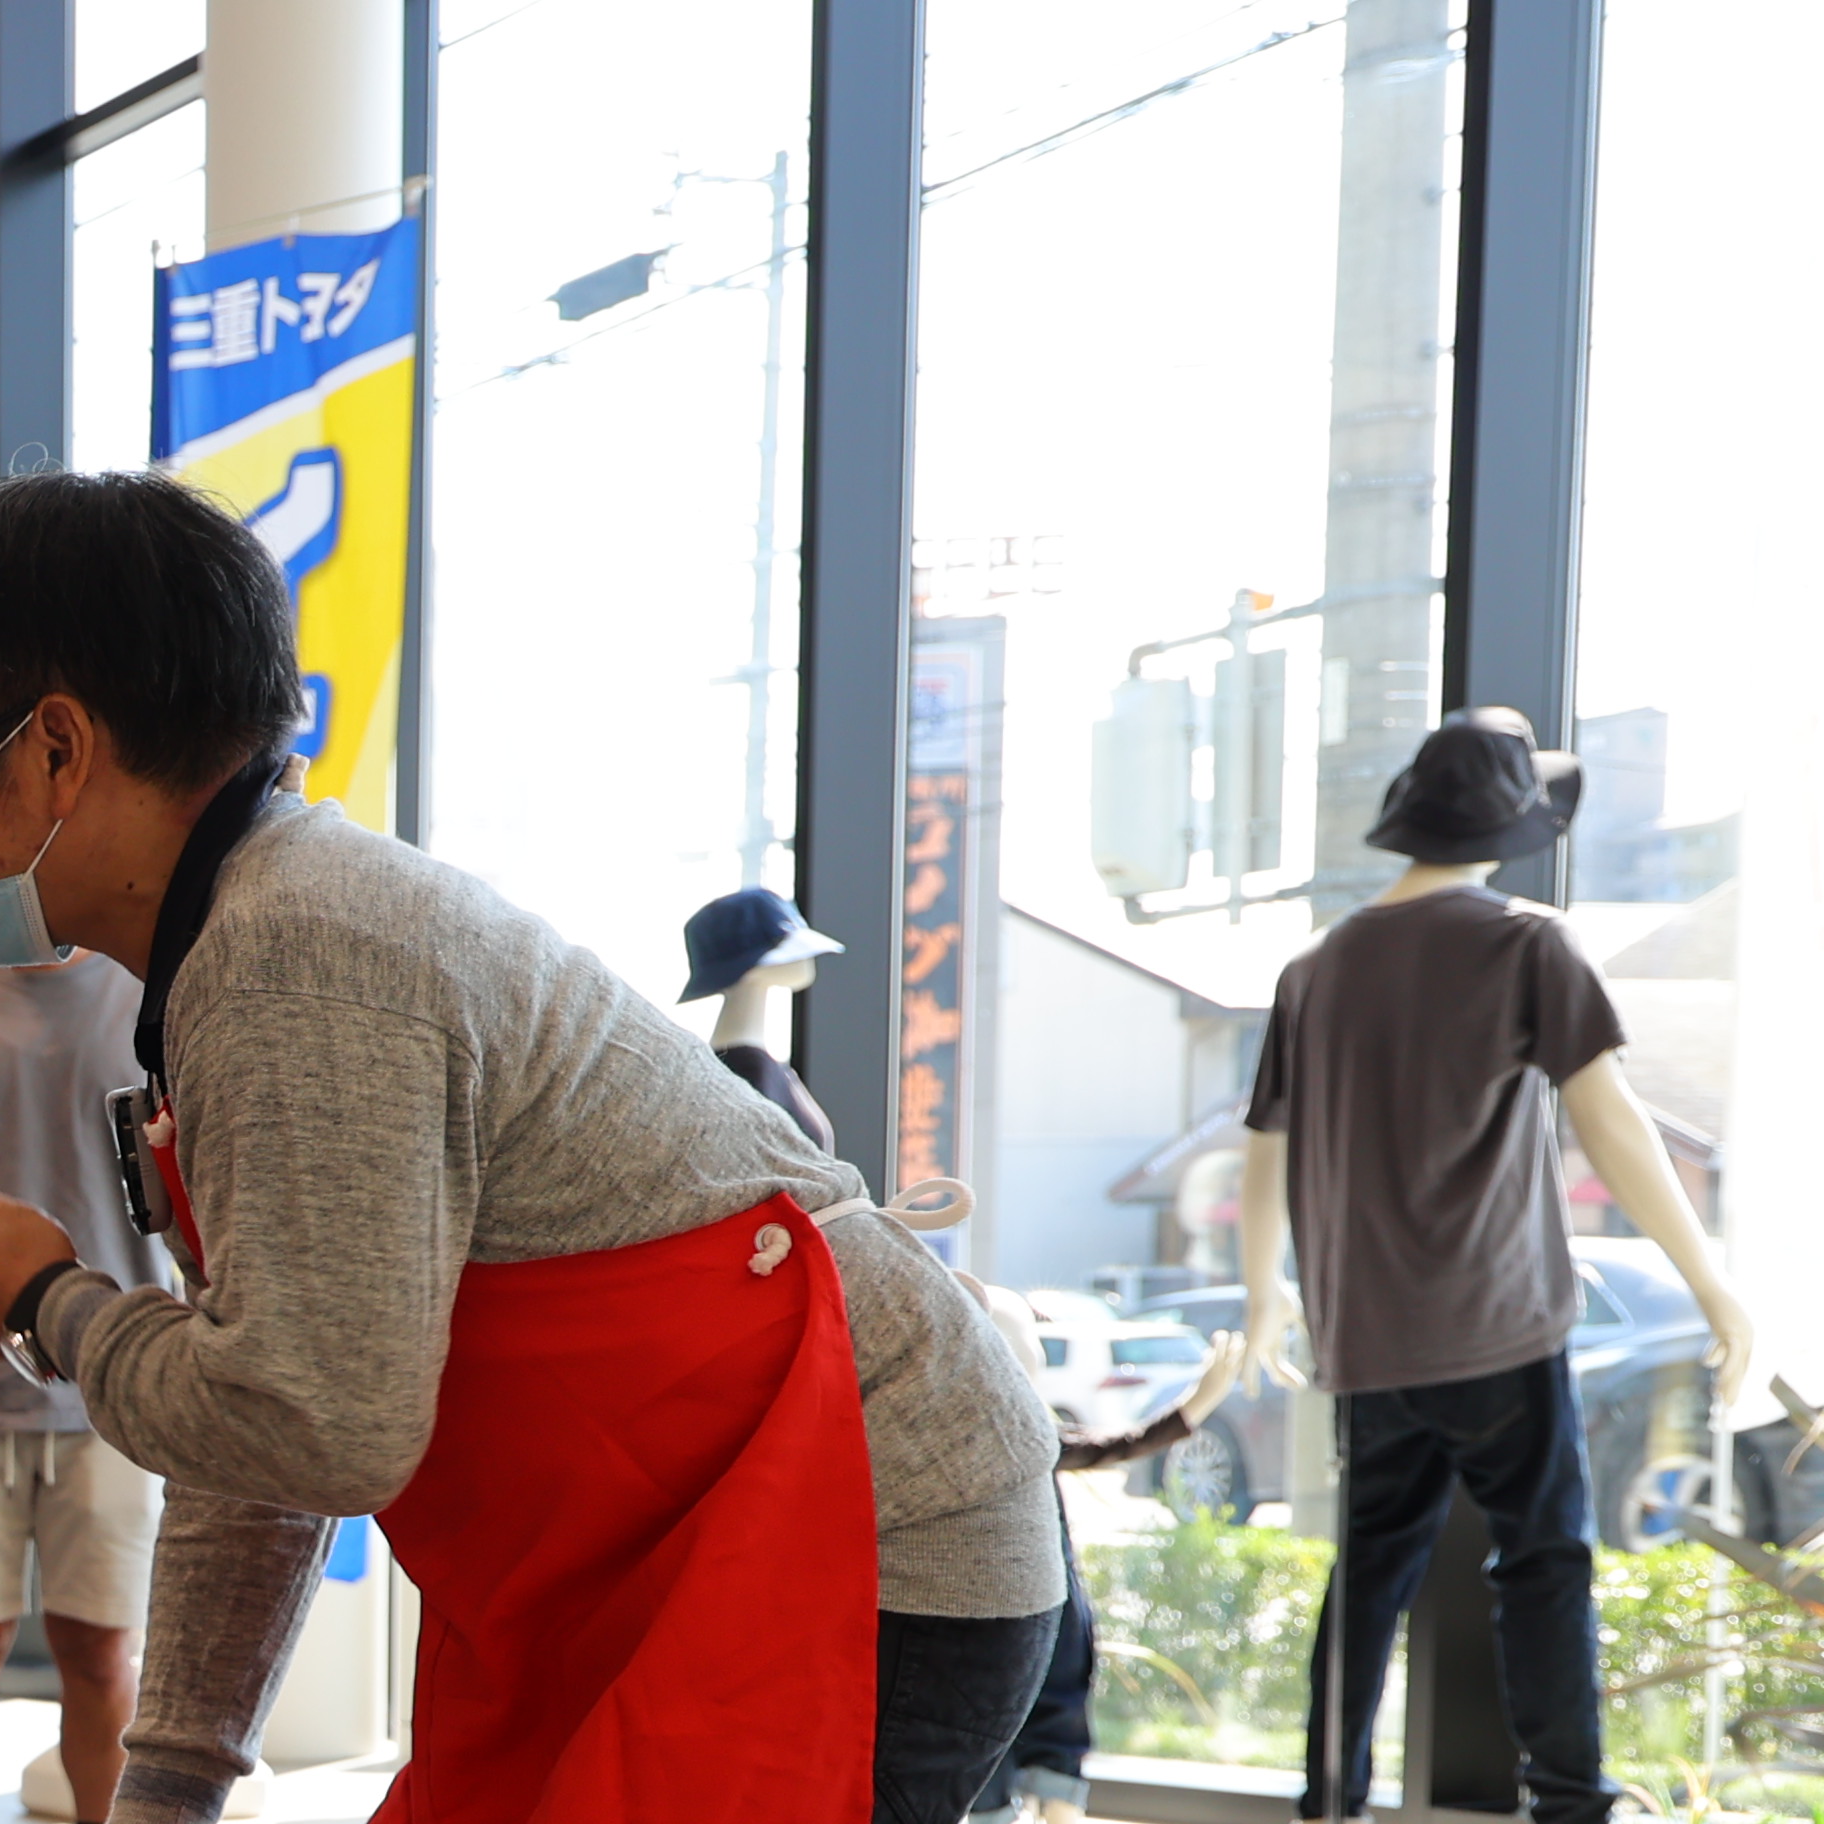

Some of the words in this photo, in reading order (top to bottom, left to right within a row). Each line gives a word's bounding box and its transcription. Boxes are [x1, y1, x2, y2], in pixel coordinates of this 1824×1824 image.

[169, 257, 380, 371] 三重トヨタ
